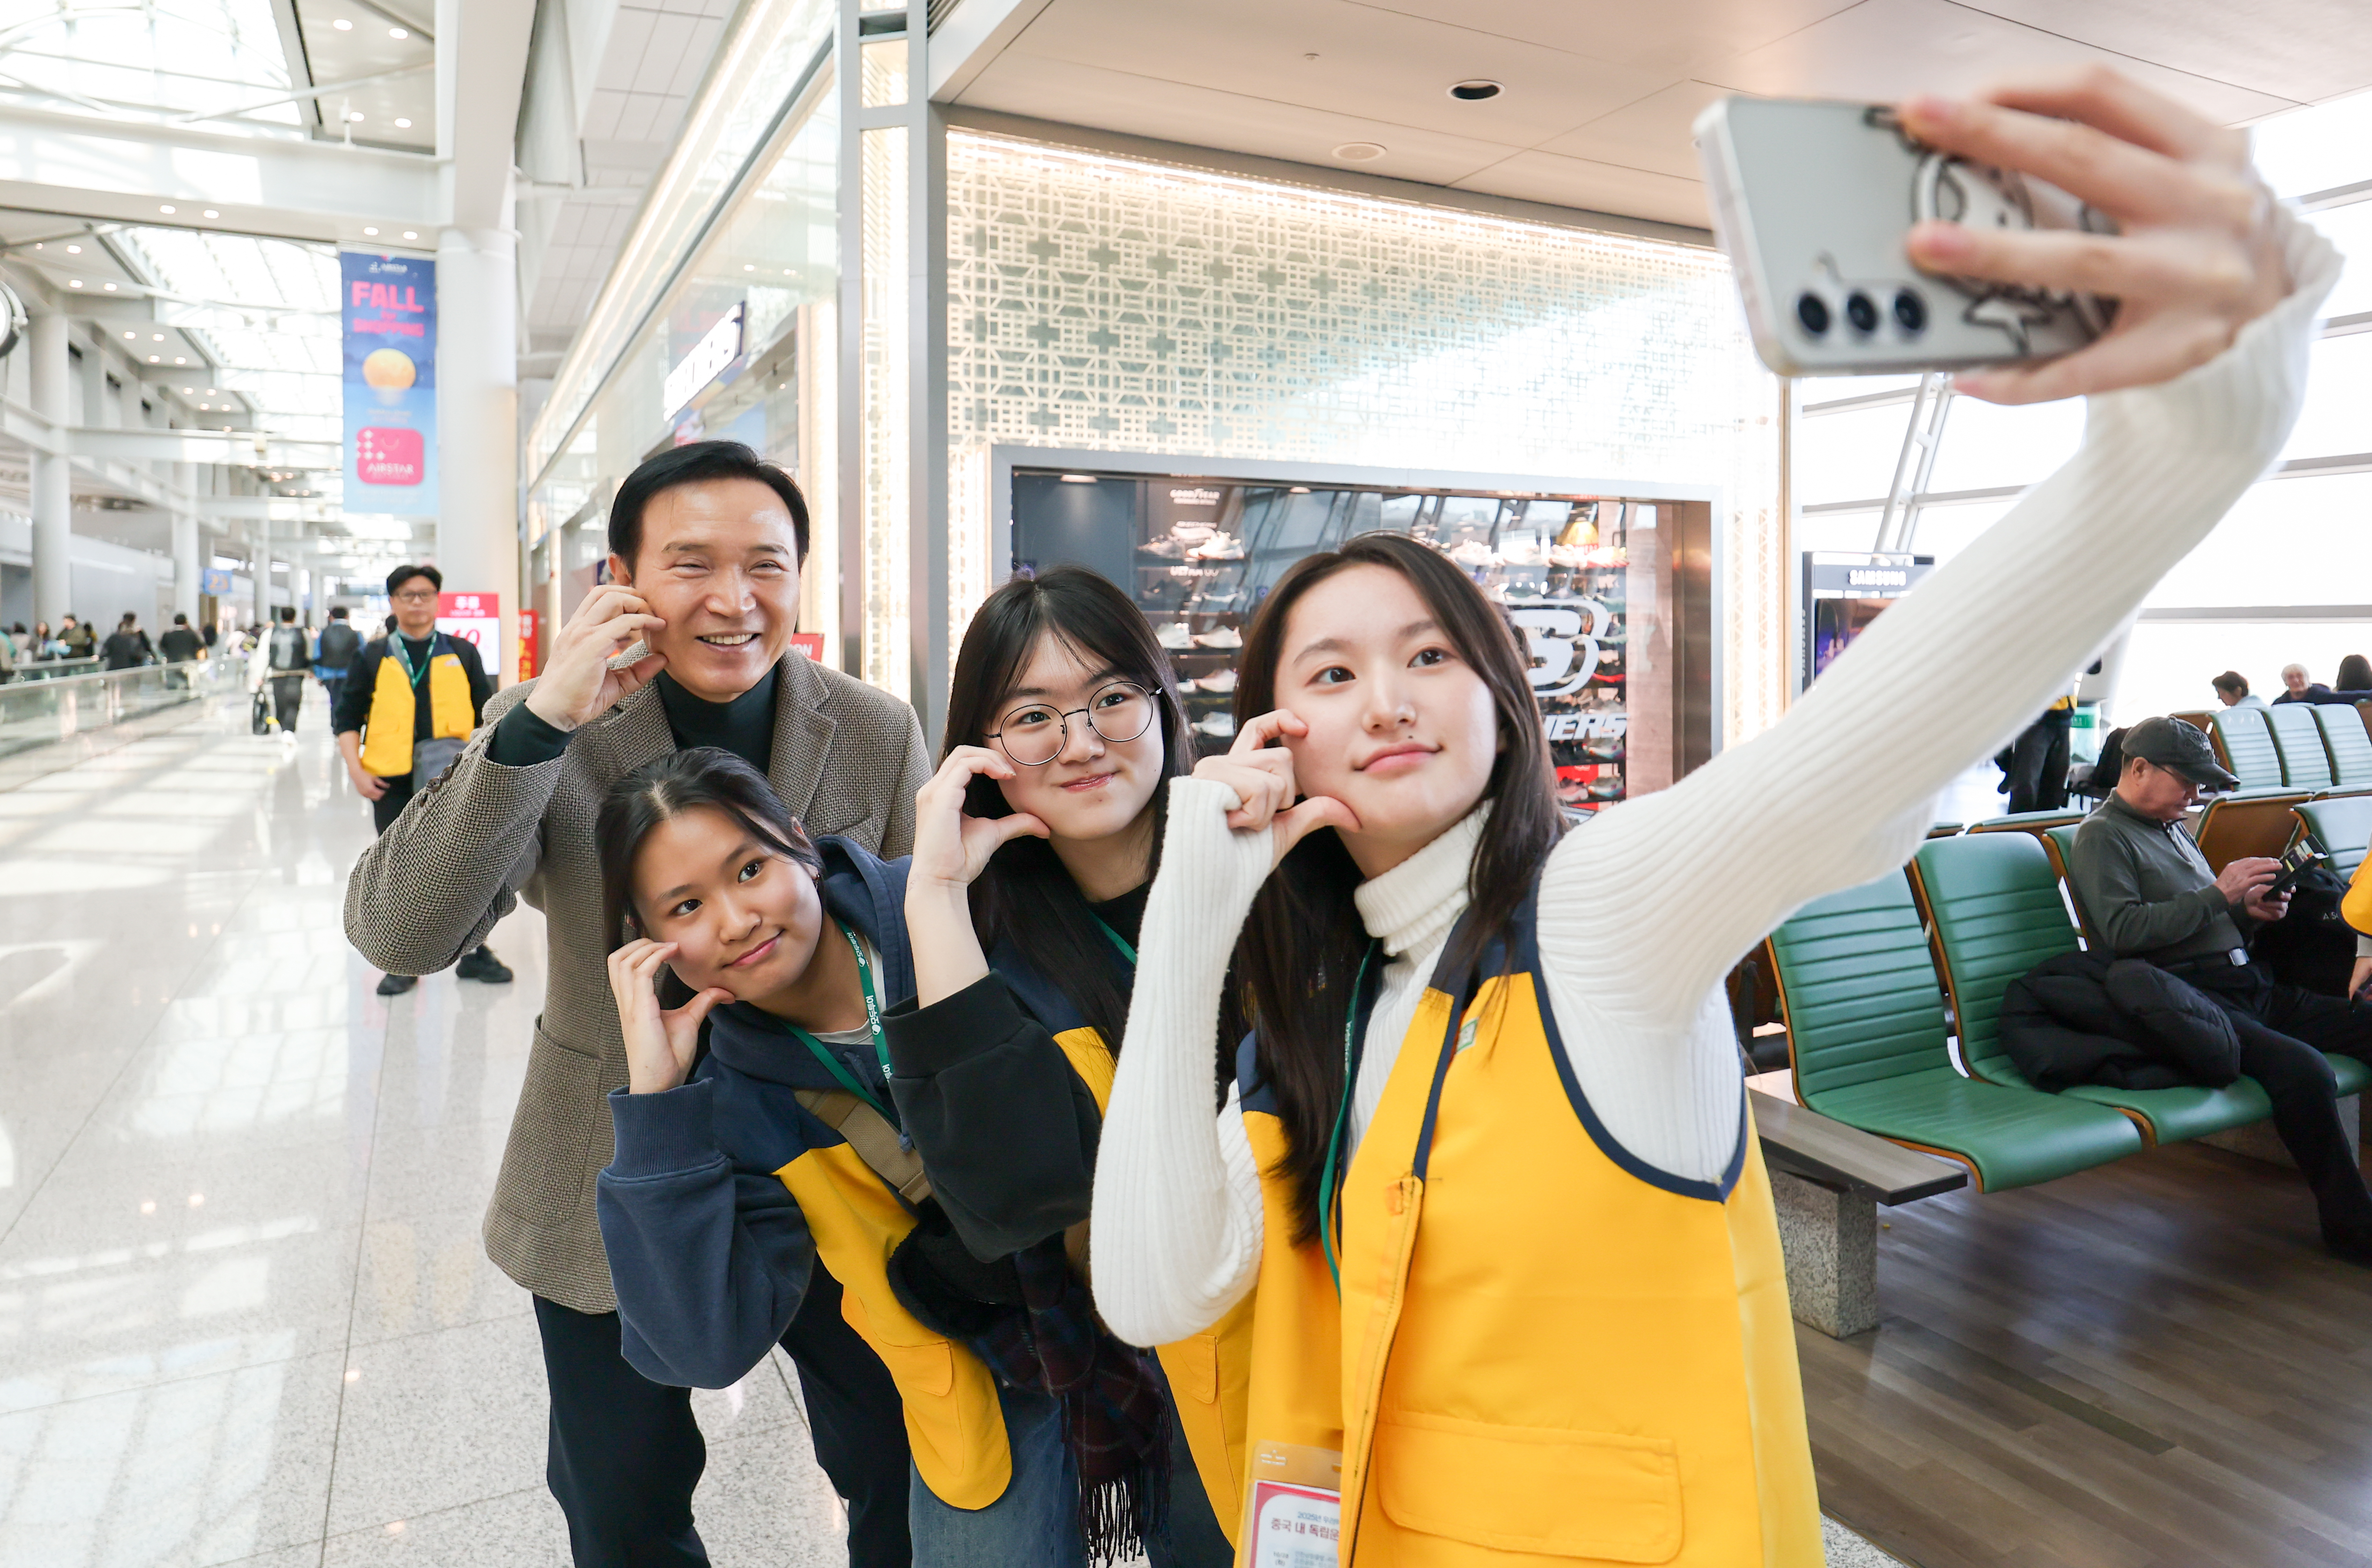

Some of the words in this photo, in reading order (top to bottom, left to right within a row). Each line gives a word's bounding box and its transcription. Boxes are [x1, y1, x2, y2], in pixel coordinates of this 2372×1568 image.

[353, 281, 425, 312] FALL
[366, 462, 414, 475] AIRSTAR
[1848, 570, 1906, 586] SAMSUNG
[789, 643, 813, 657] ON
[1544, 712, 1630, 741] ERS
[847, 932, 864, 957] 모두투어
[865, 995, 879, 1025] 모두투어
[1271, 1517, 1291, 1532] 중국
[1295, 1522, 1305, 1534] 내
